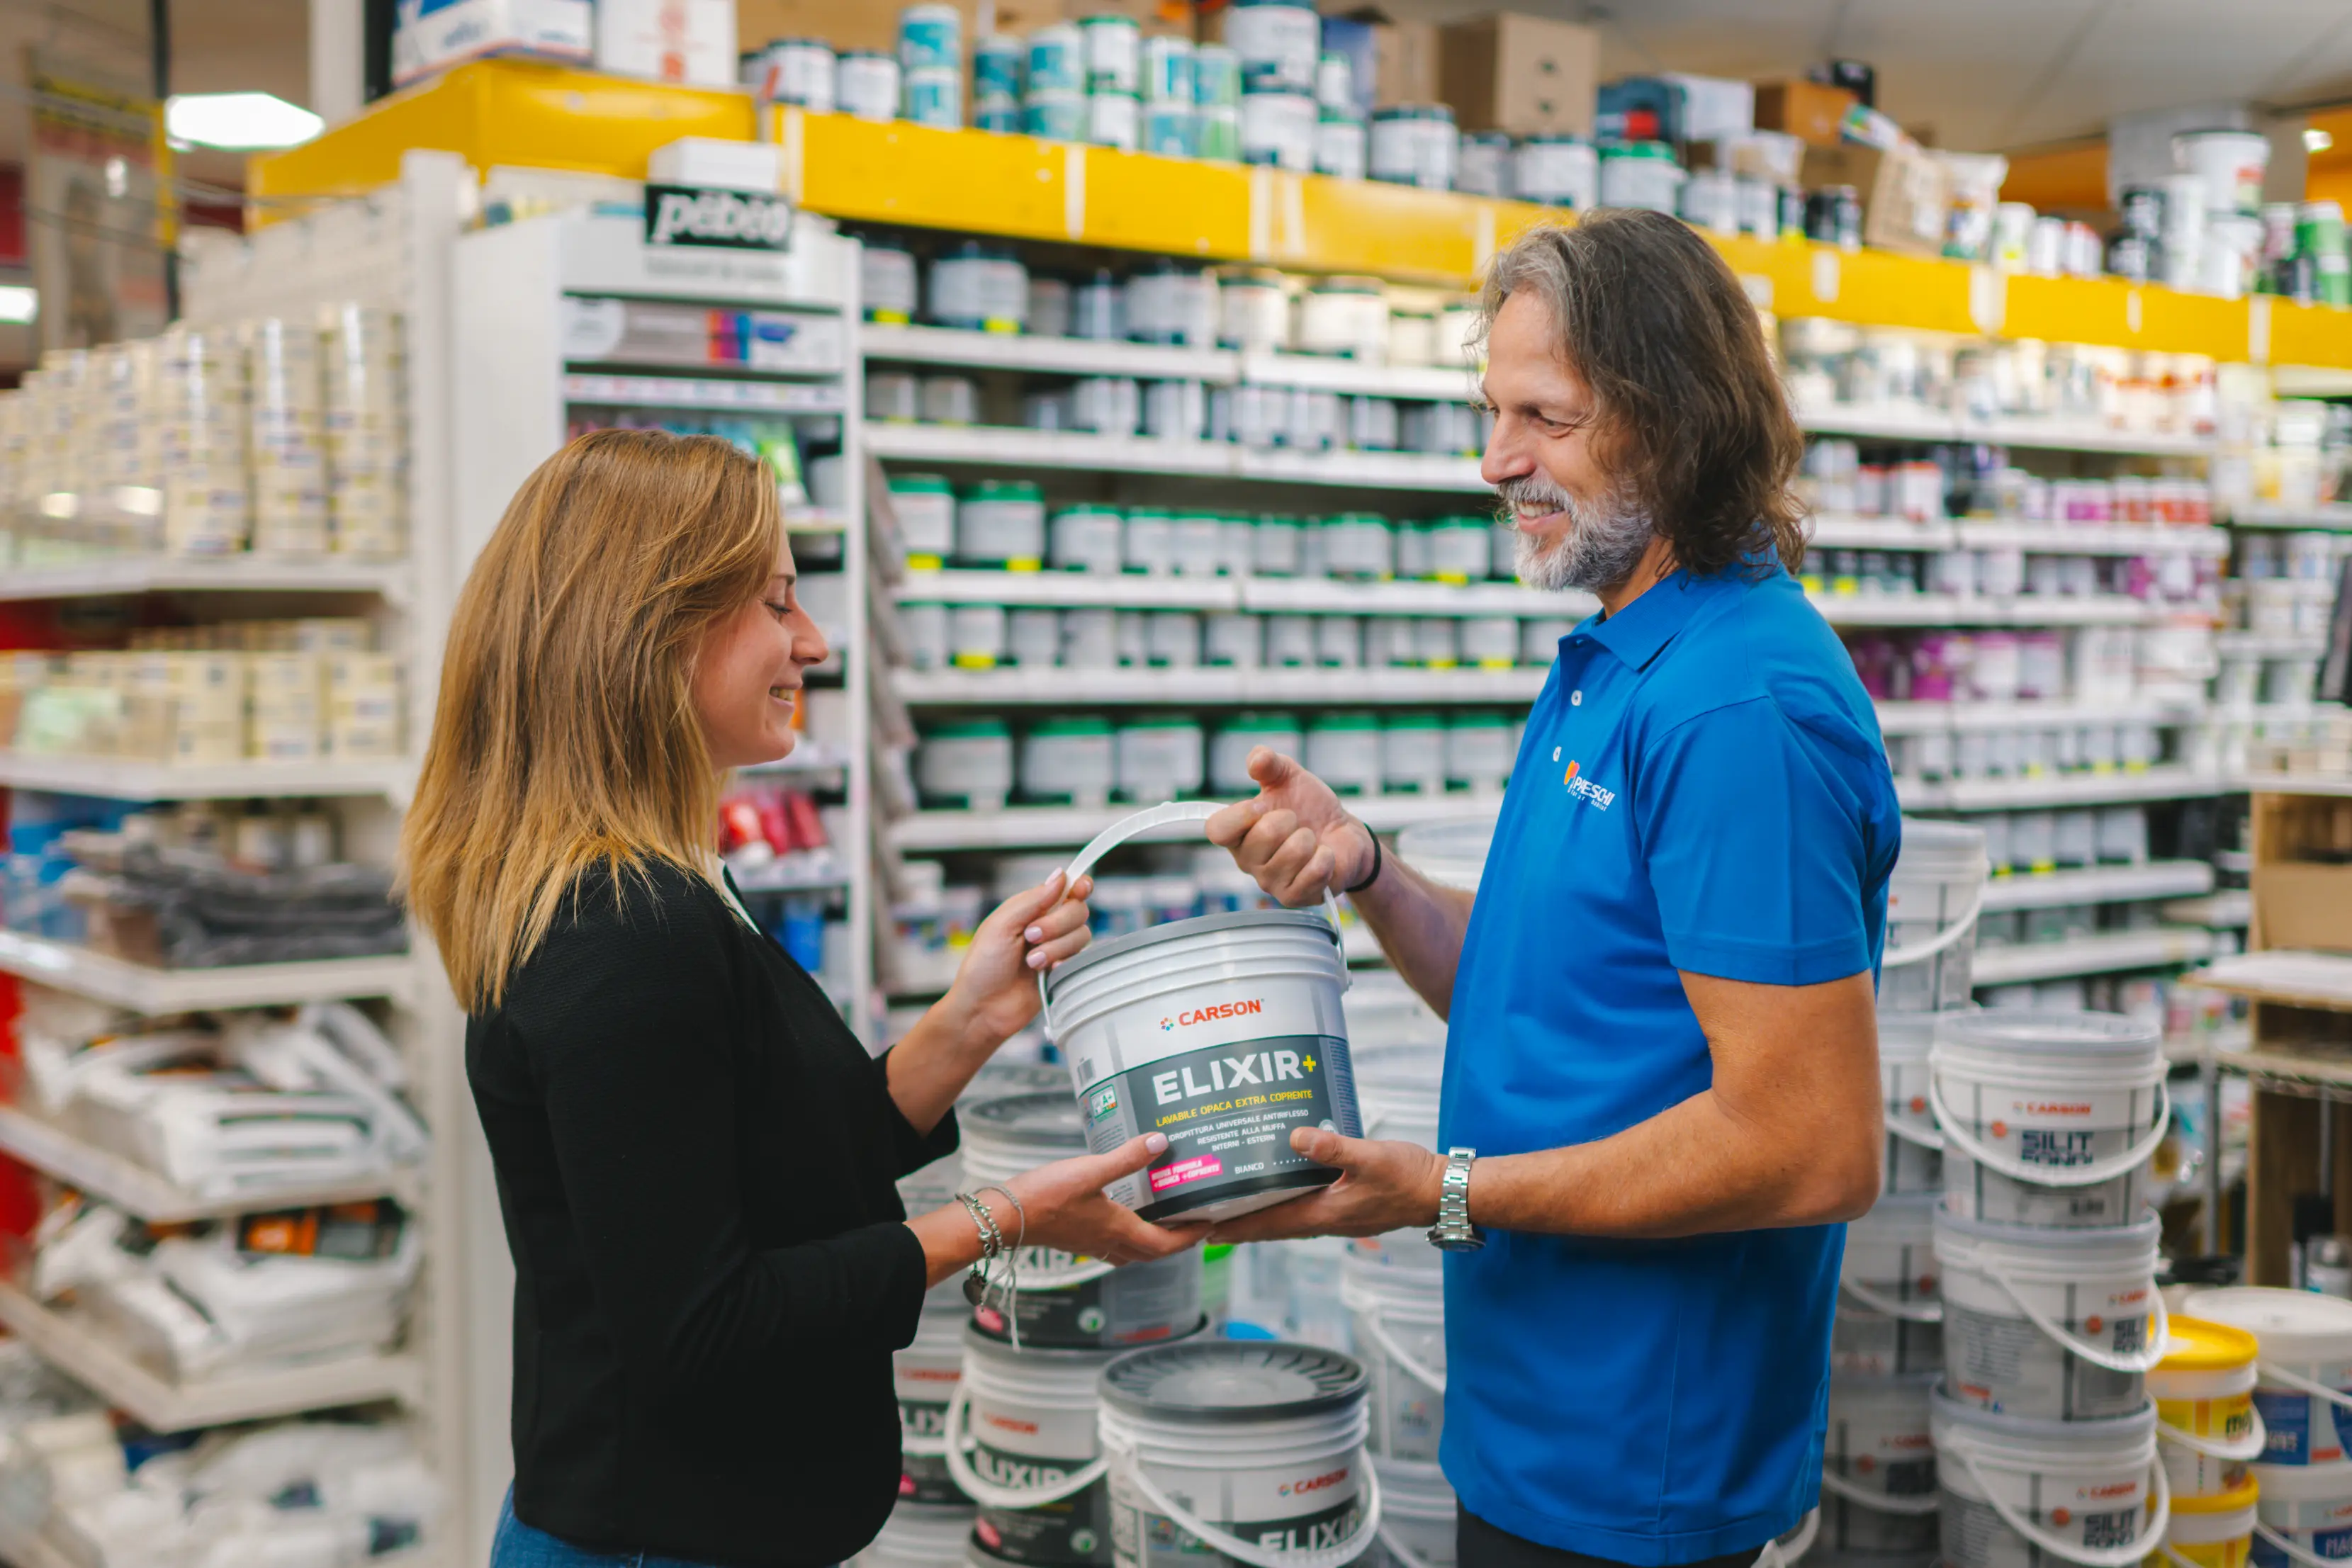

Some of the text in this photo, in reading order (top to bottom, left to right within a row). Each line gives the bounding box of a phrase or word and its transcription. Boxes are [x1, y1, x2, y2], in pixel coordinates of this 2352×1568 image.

[1178, 998, 1261, 1026] CARSON
[1156, 1089, 1313, 1127] LAVABILE OPACA EXTRA COPRENTE
[1168, 1109, 1309, 1142] IDROPITTURA UNIVERSALE ANTIRIFLESSO
[1197, 1122, 1286, 1146] RESISTENTE ALLA MUFFA
[1212, 1139, 1240, 1152] INTERNI
[1247, 1134, 1276, 1145] ESTERNI
[1234, 1162, 1265, 1175] BIANCO
